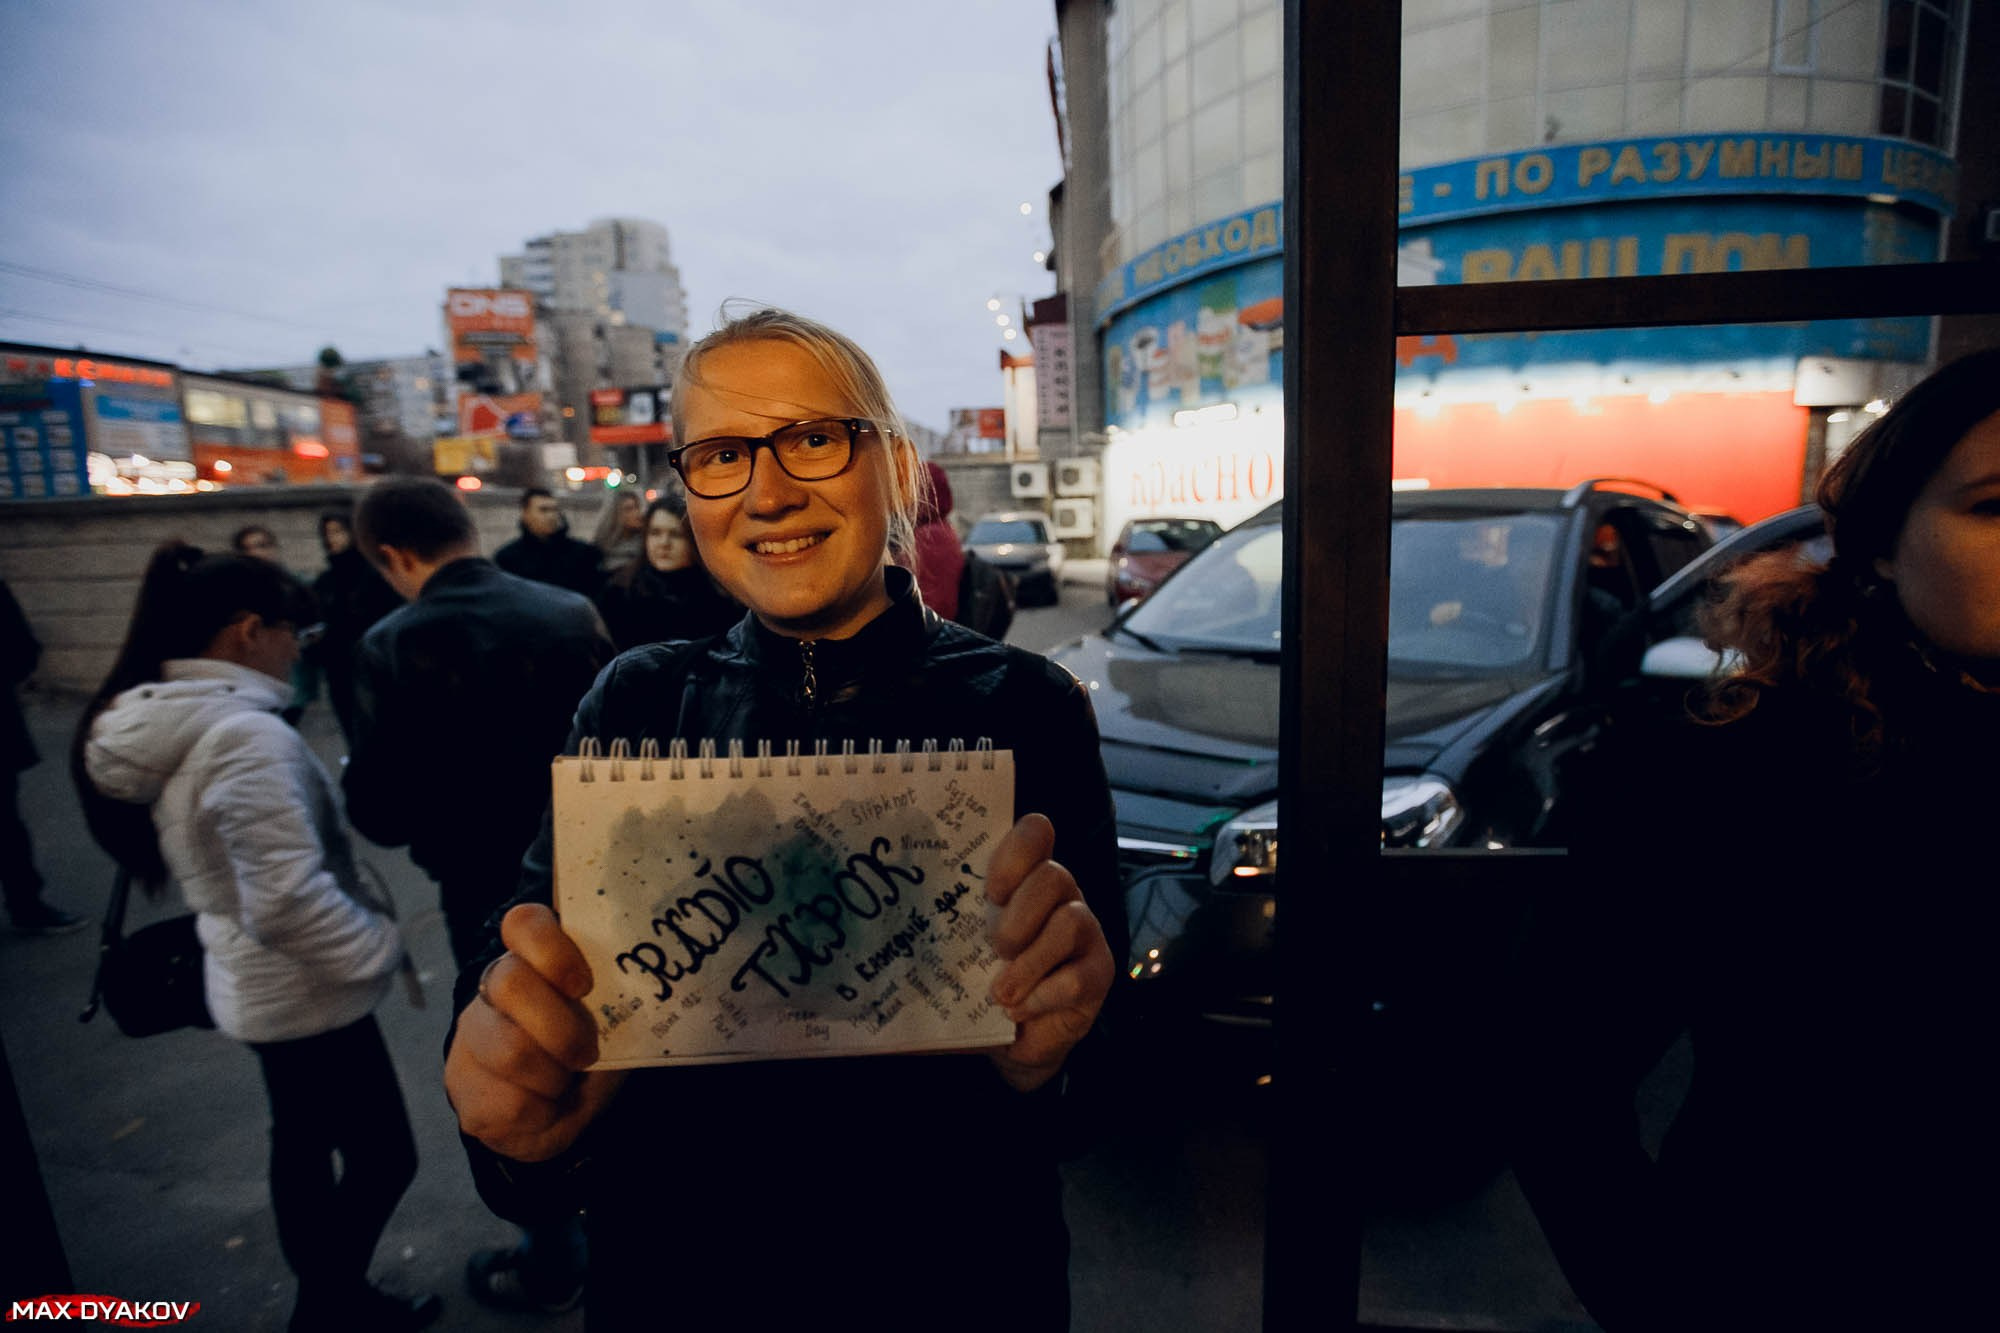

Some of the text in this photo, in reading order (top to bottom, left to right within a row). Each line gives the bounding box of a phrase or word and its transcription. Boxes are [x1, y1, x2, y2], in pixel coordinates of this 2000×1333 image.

[1475, 154, 1554, 200] ПО
[1578, 138, 1863, 188] РАЗУМНЫМ
[792, 791, 844, 840] Imagine
[850, 786, 917, 826] Slipknot
[900, 833, 951, 851] Nirvana
[805, 1023, 830, 1041] Day
